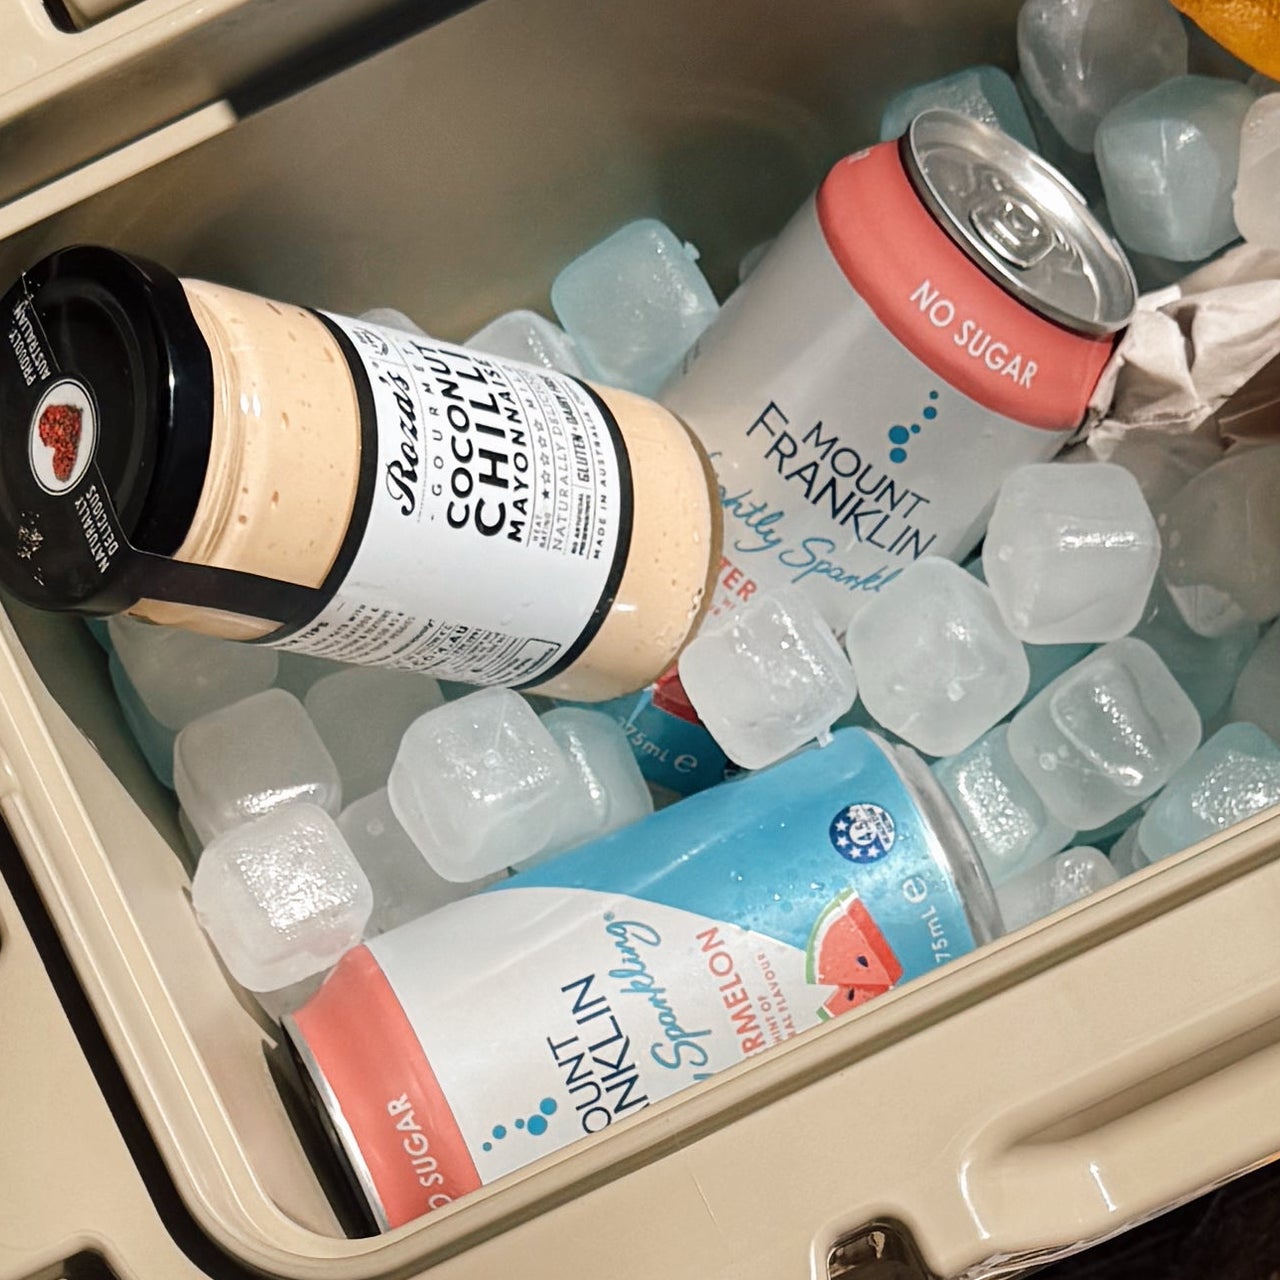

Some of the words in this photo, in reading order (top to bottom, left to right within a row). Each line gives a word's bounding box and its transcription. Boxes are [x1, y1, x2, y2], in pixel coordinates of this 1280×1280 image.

[9, 331, 36, 386] PROUDLY
[910, 279, 954, 327] NO
[953, 320, 1038, 389] SUGAR
[379, 370, 419, 516] Roza's
[409, 340, 473, 529] COCONUT
[438, 350, 508, 537] CHILLI
[474, 357, 529, 542] MAYONNAISE
[571, 432, 589, 482] GLUTEN
[746, 401, 937, 560] FRANKLIN
[802, 420, 931, 518] MOUNT
[75, 496, 109, 573] NATURALLY
[86, 485, 119, 556] DELICIOUS
[552, 443, 570, 551] NATURALLY
[594, 518, 606, 559] MADE
[600, 494, 607, 510] IN
[921, 905, 951, 963] 75ml
[605, 920, 713, 1070] Sparkling
[695, 926, 767, 1055] RMELON
[757, 952, 792, 1025] FLAVOUR
[547, 1036, 611, 1134] OUNT
[560, 973, 651, 1115] NKLIN
[387, 1092, 444, 1186] SUGAR
